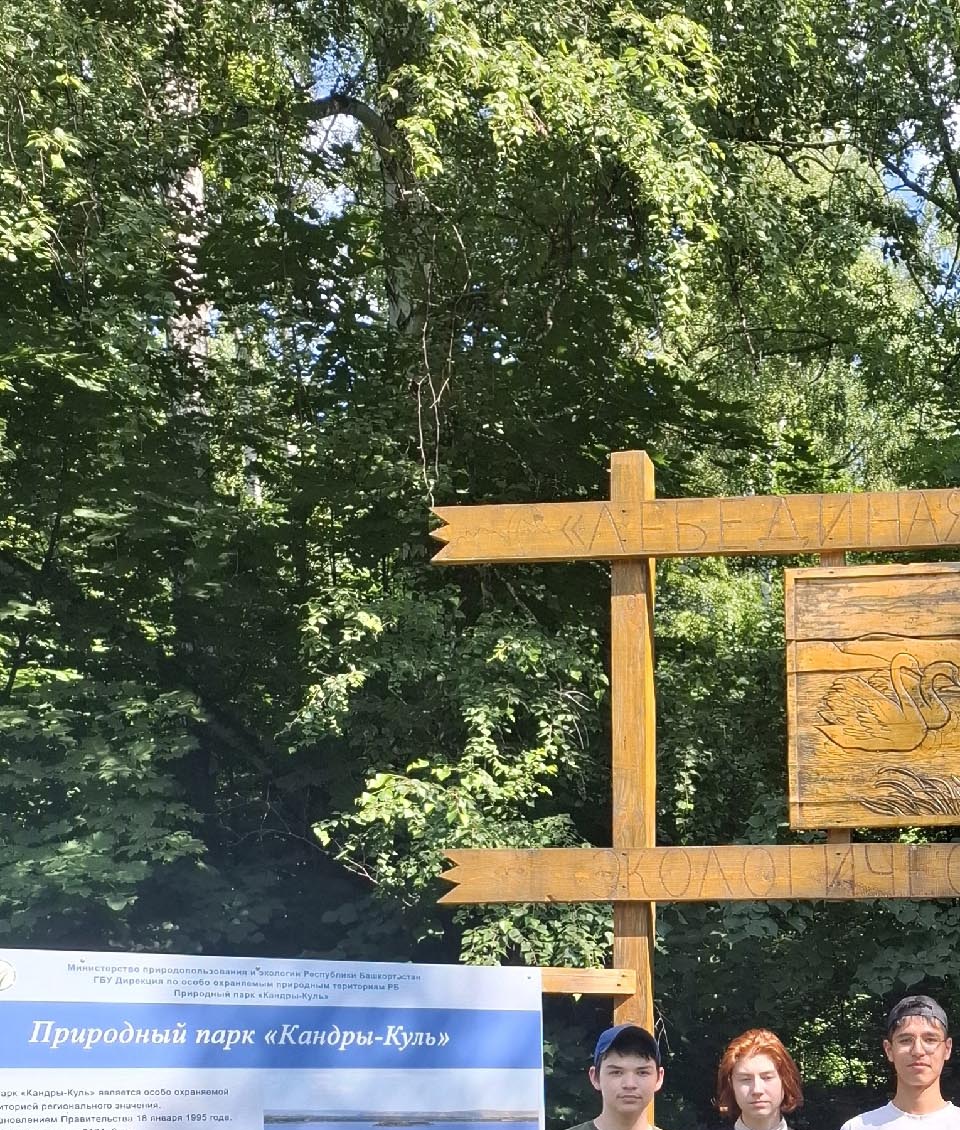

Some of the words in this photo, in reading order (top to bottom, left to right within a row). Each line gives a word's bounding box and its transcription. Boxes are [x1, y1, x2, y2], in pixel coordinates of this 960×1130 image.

[93, 975, 112, 985] ГБУ
[174, 988, 231, 999] Природный
[28, 1020, 188, 1049] Природный
[195, 1026, 256, 1051] парк
[264, 1023, 451, 1051] «Кандры-Куль»
